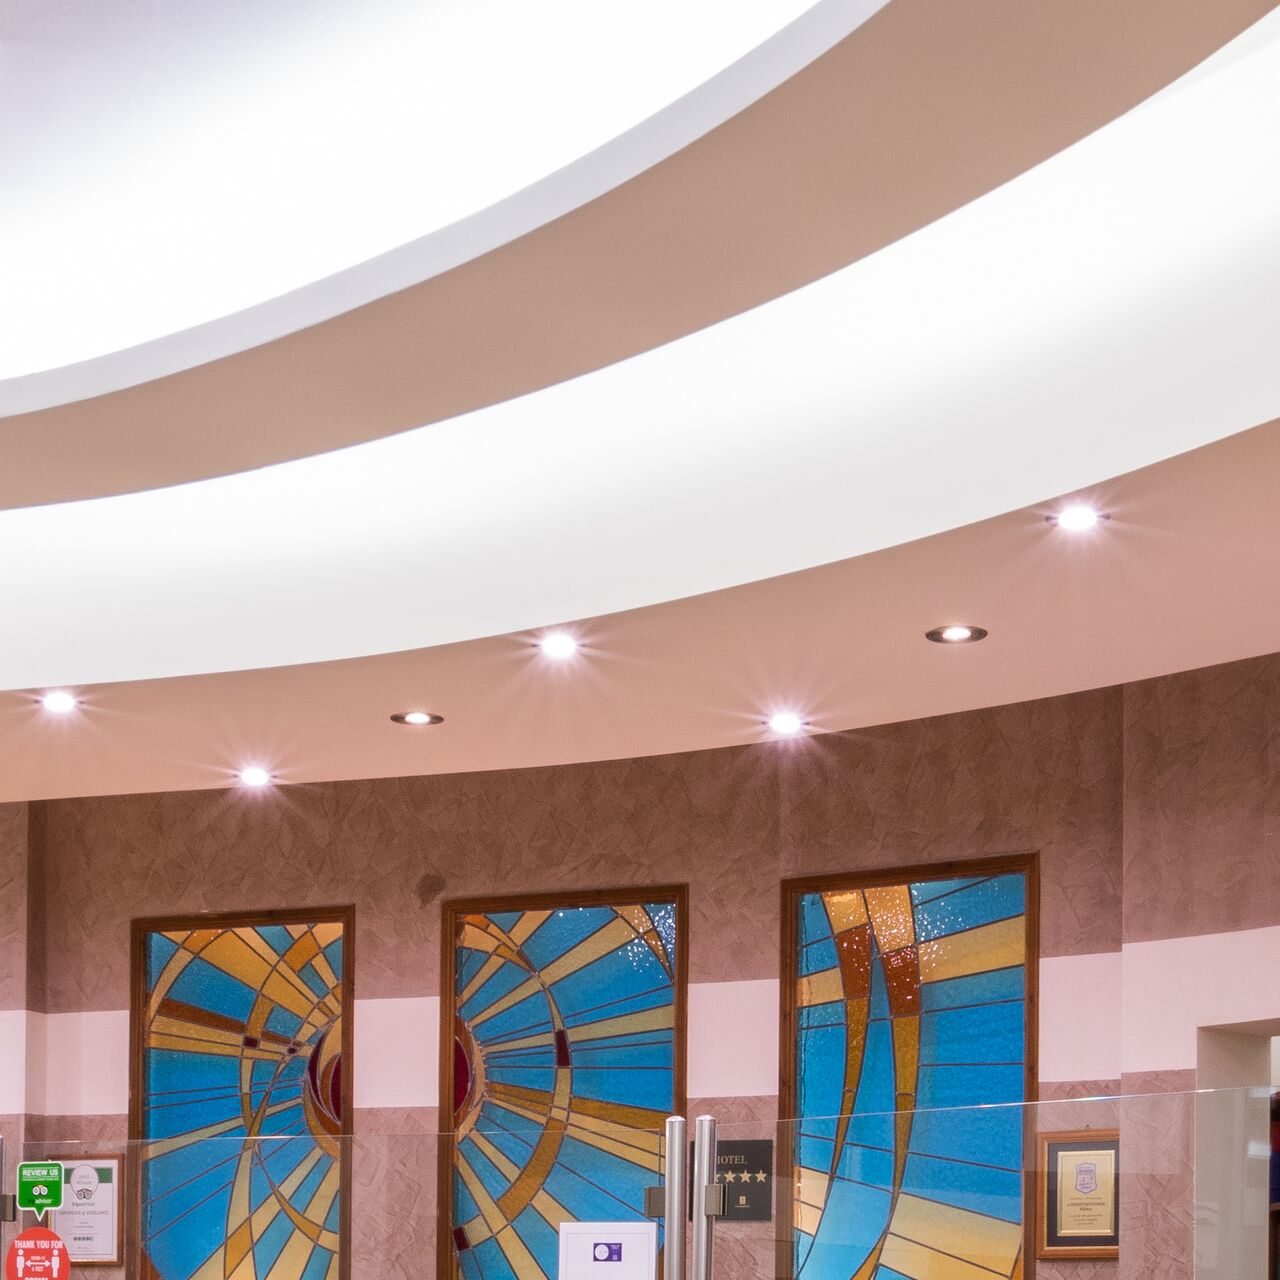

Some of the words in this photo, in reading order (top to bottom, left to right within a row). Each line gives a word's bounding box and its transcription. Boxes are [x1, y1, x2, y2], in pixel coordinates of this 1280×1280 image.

[14, 1239, 36, 1249] THANK
[36, 1239, 50, 1249] YOU
[51, 1239, 63, 1249] FOR
